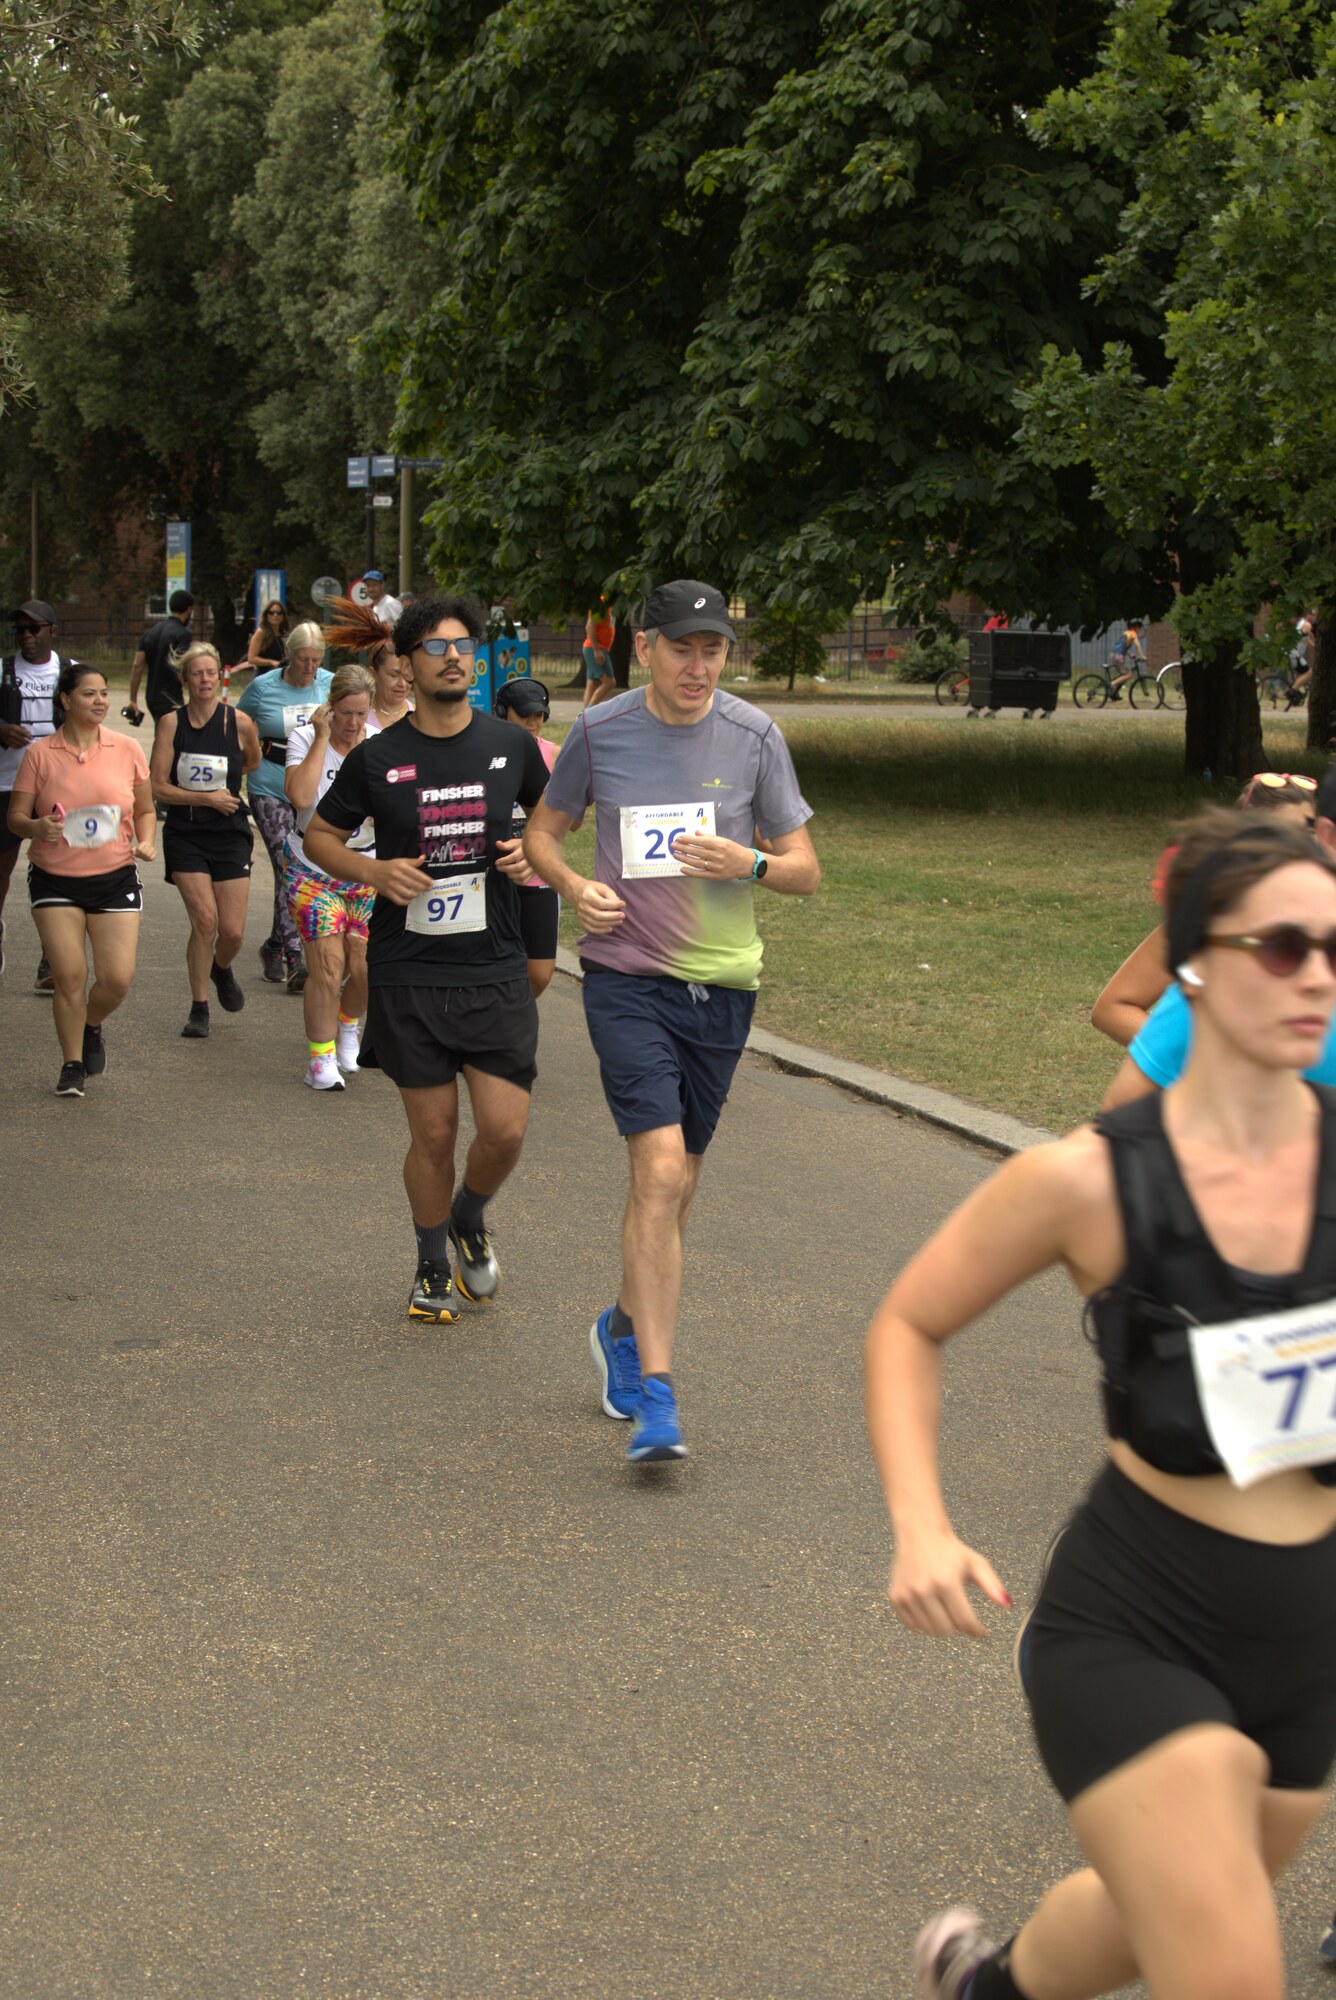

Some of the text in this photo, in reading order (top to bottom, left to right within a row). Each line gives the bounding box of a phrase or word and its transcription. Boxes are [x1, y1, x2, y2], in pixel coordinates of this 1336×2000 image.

[359, 587, 368, 600] 5
[296, 714, 314, 728] 5
[190, 766, 213, 782] 25
[422, 785, 485, 803] FINISHER
[423, 803, 486, 821] FINISHER
[696, 807, 704, 818] A
[85, 817, 98, 838] 9
[424, 821, 486, 838] FINISHER
[470, 877, 478, 886] A
[427, 894, 464, 923] 97
